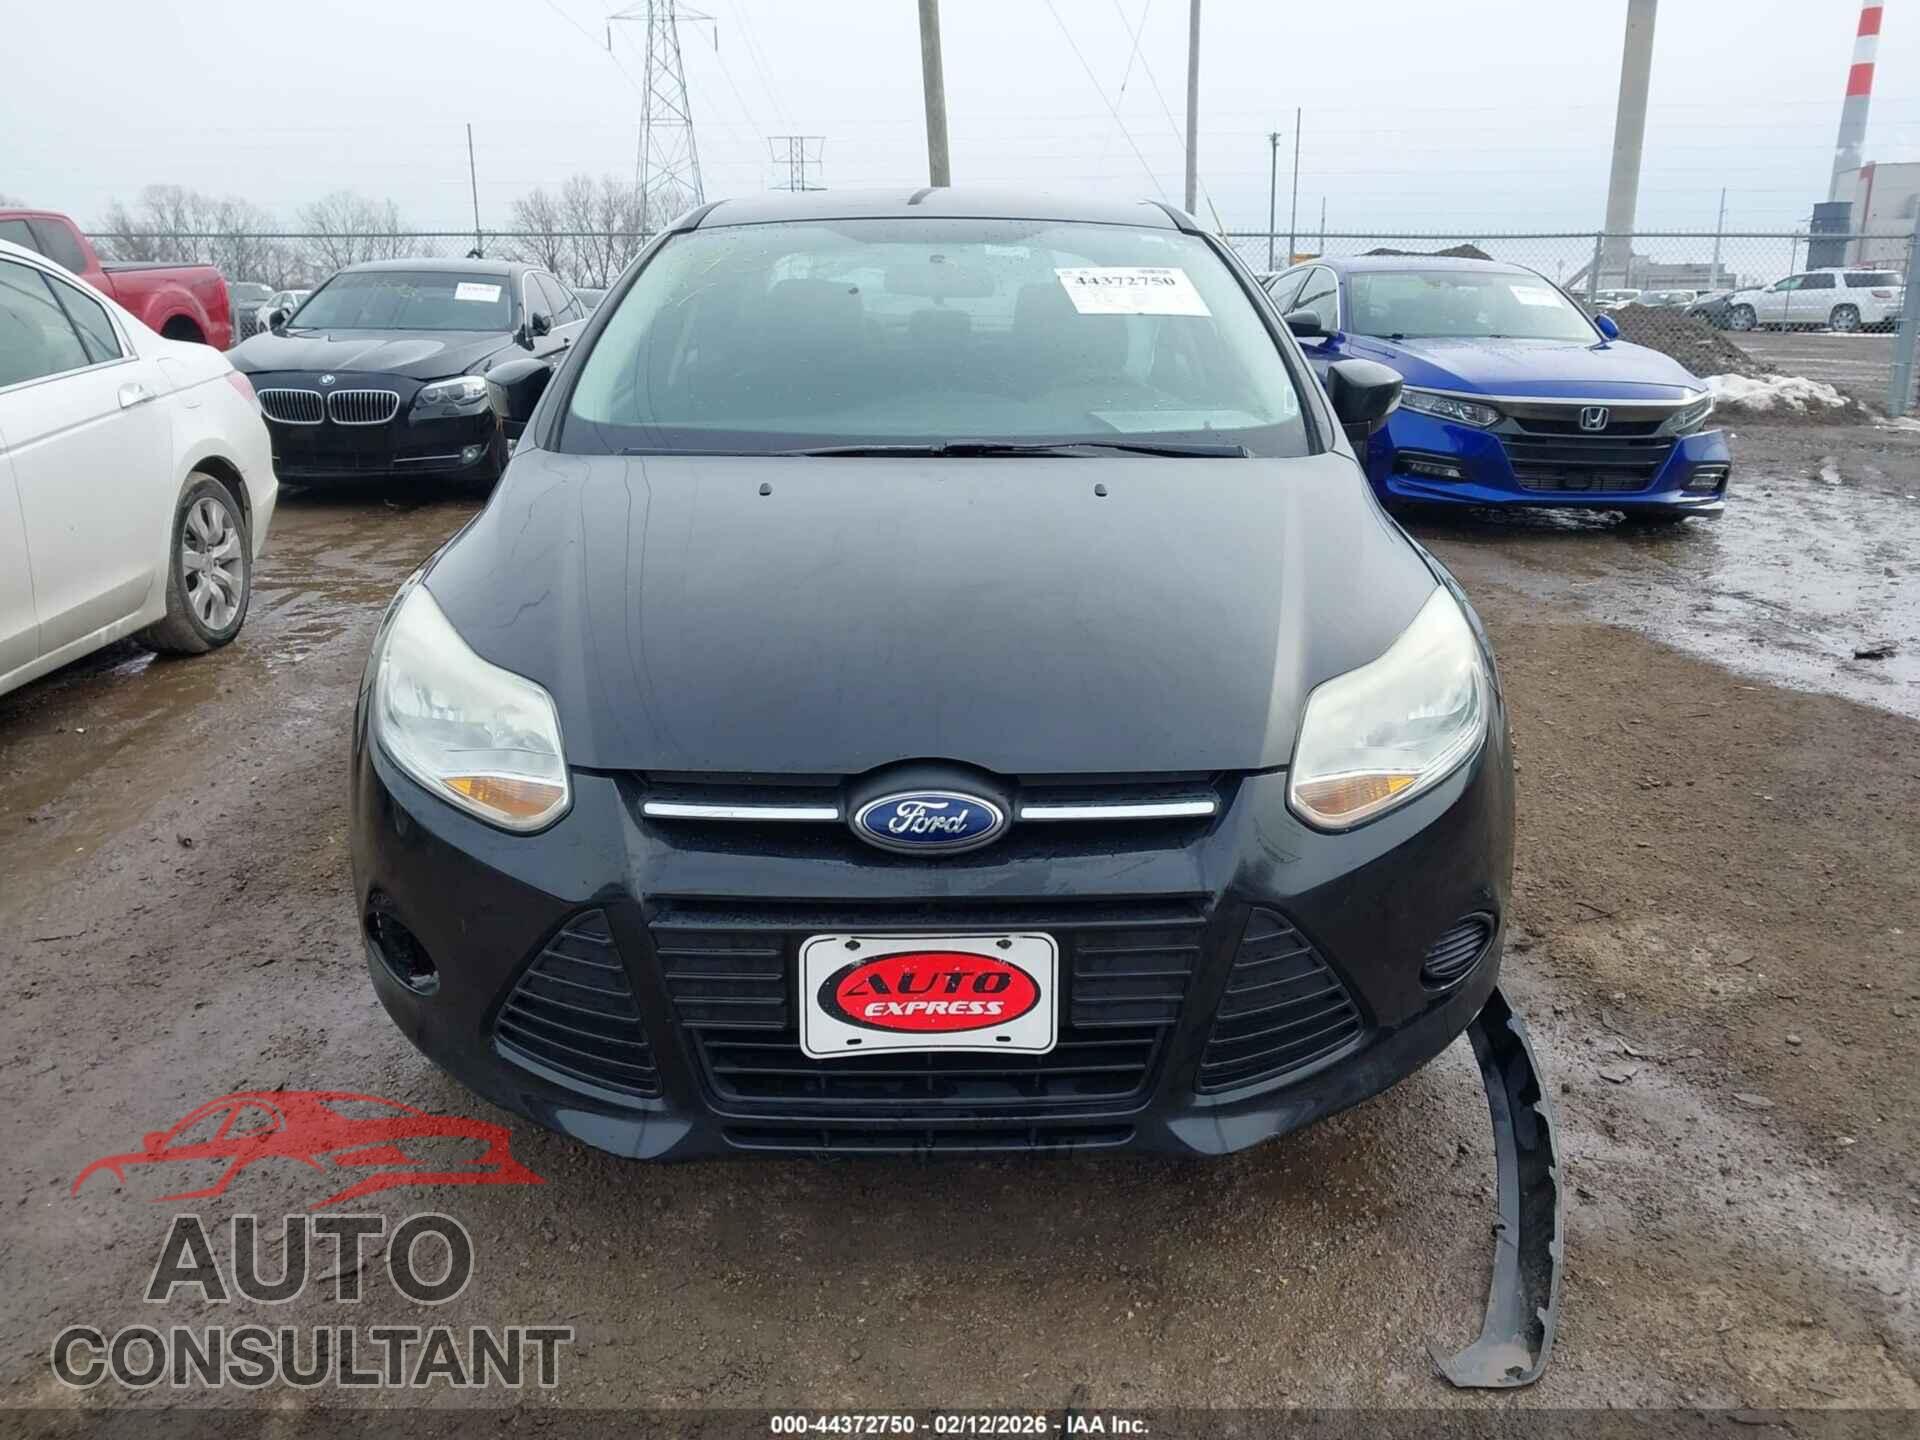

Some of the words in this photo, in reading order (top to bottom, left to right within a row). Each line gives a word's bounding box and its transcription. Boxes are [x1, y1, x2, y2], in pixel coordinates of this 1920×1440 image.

[1074, 275, 1177, 287] 44372750
[888, 800, 969, 834] Ford
[842, 971, 1013, 997] AUTO
[864, 1000, 1005, 1017] EXPRESS
